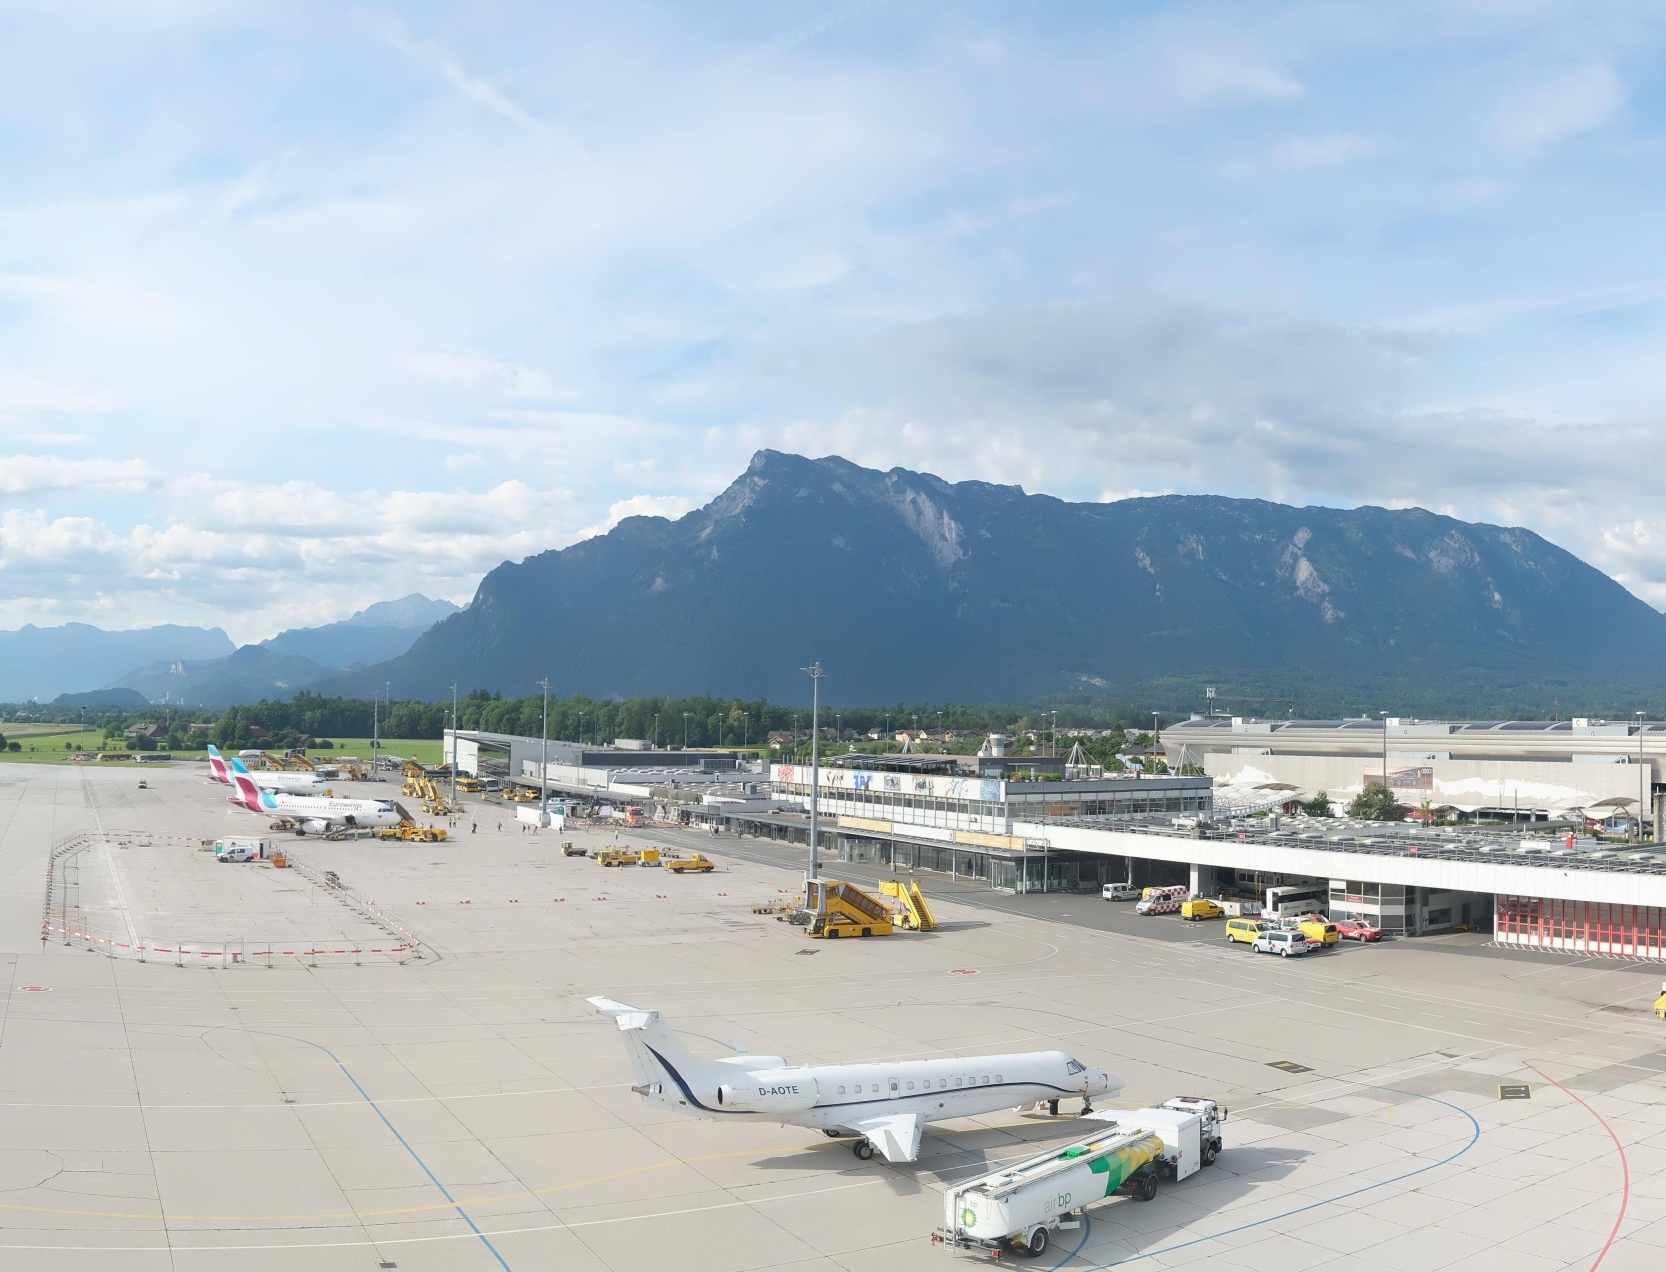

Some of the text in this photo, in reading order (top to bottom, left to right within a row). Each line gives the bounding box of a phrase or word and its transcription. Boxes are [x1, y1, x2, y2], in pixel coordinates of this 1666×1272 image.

[329, 801, 363, 811] Eurowings
[758, 1085, 799, 1096] D-AOTE
[1044, 1192, 1072, 1214] air bp
